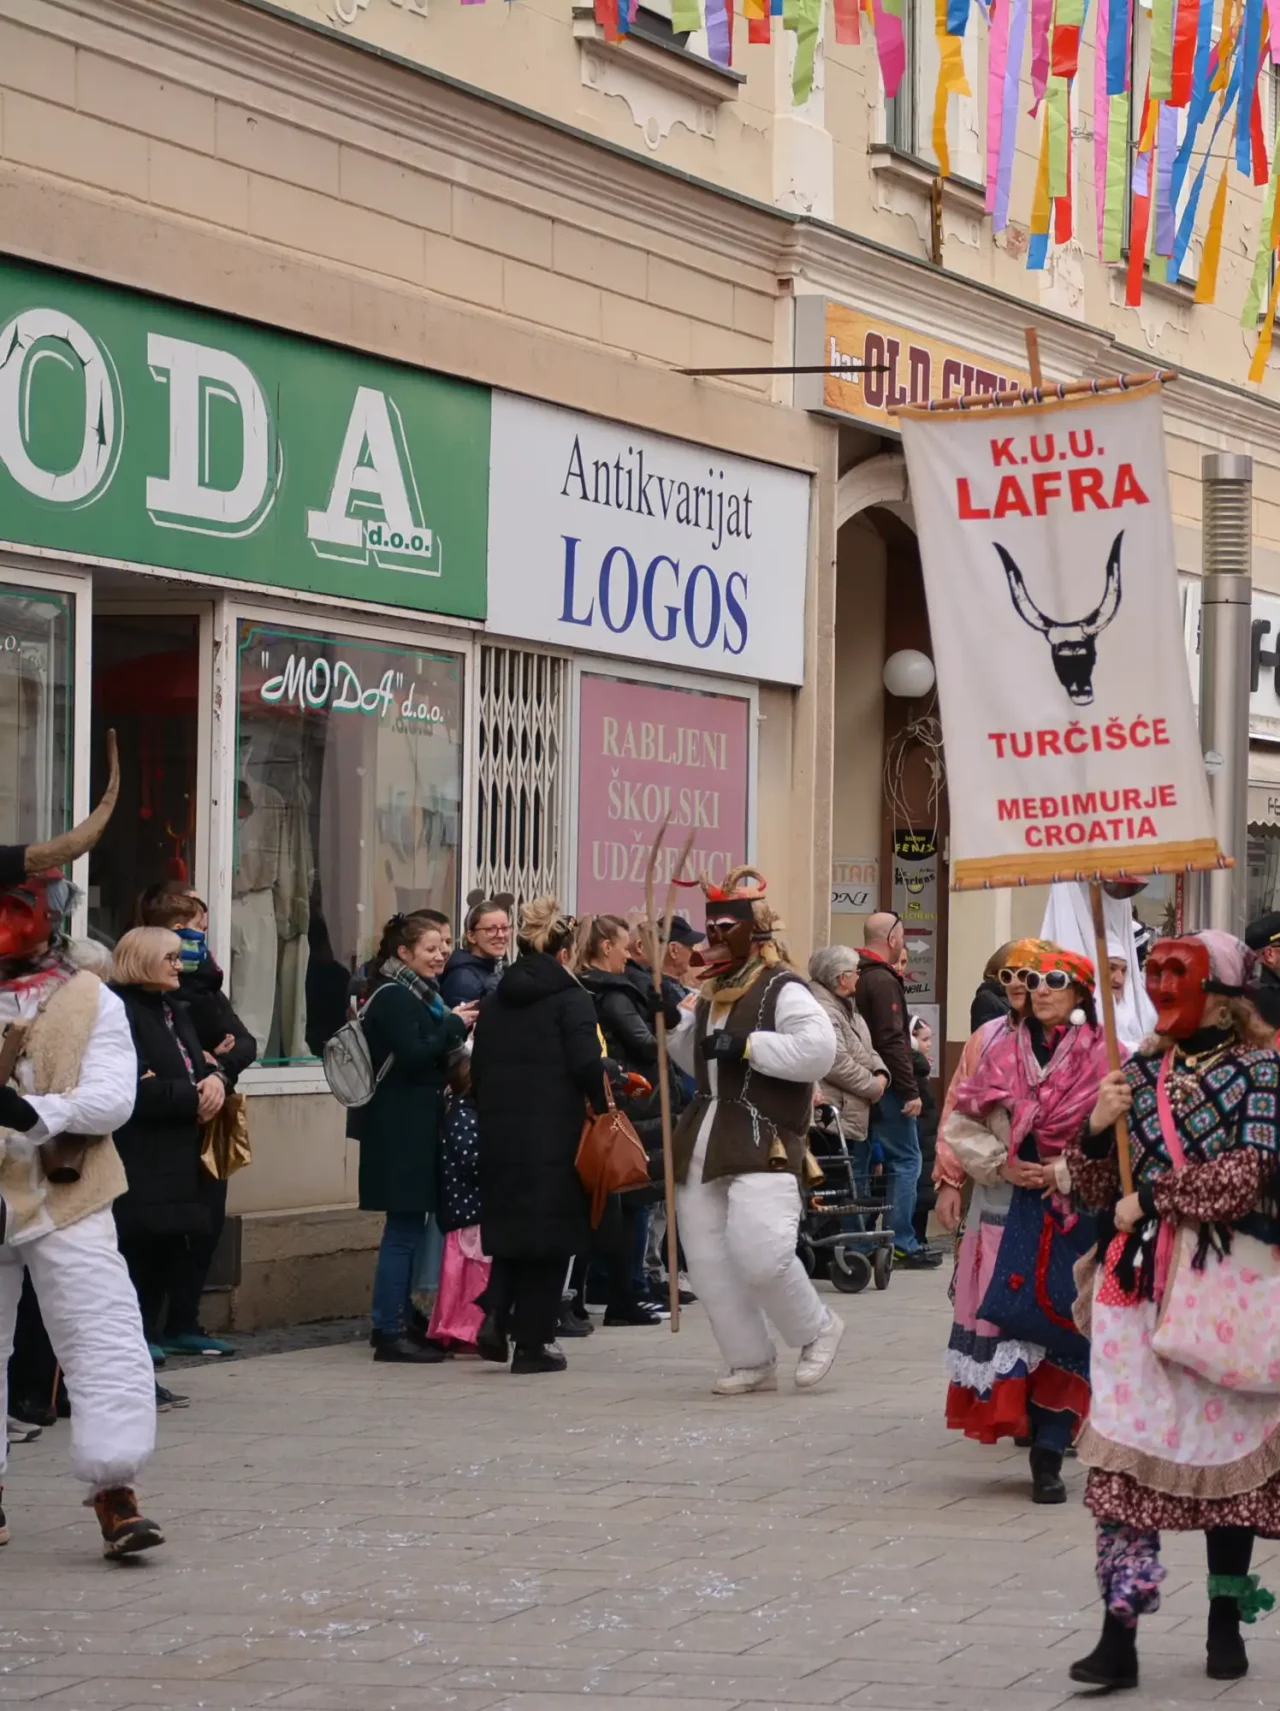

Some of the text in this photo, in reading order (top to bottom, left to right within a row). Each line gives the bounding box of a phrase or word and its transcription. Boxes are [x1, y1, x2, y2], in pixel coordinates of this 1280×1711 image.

[829, 336, 862, 384] bar
[863, 331, 931, 409] OLD
[990, 429, 1105, 466] K.U.U.
[560, 434, 753, 550] Antikvarijat
[956, 463, 1150, 521] LAFRA
[368, 529, 431, 554] d.o.o.
[557, 534, 749, 655] LOGOS
[401, 682, 444, 722] d.o.o.
[601, 716, 729, 771] RABLJENI
[988, 713, 1170, 758] TURČIŠĆE
[607, 766, 721, 829] ŠKOLSKI
[997, 784, 1178, 821] MEĐIMURJE
[895, 843, 936, 852] FENIX
[1024, 816, 1158, 848] CROATIA
